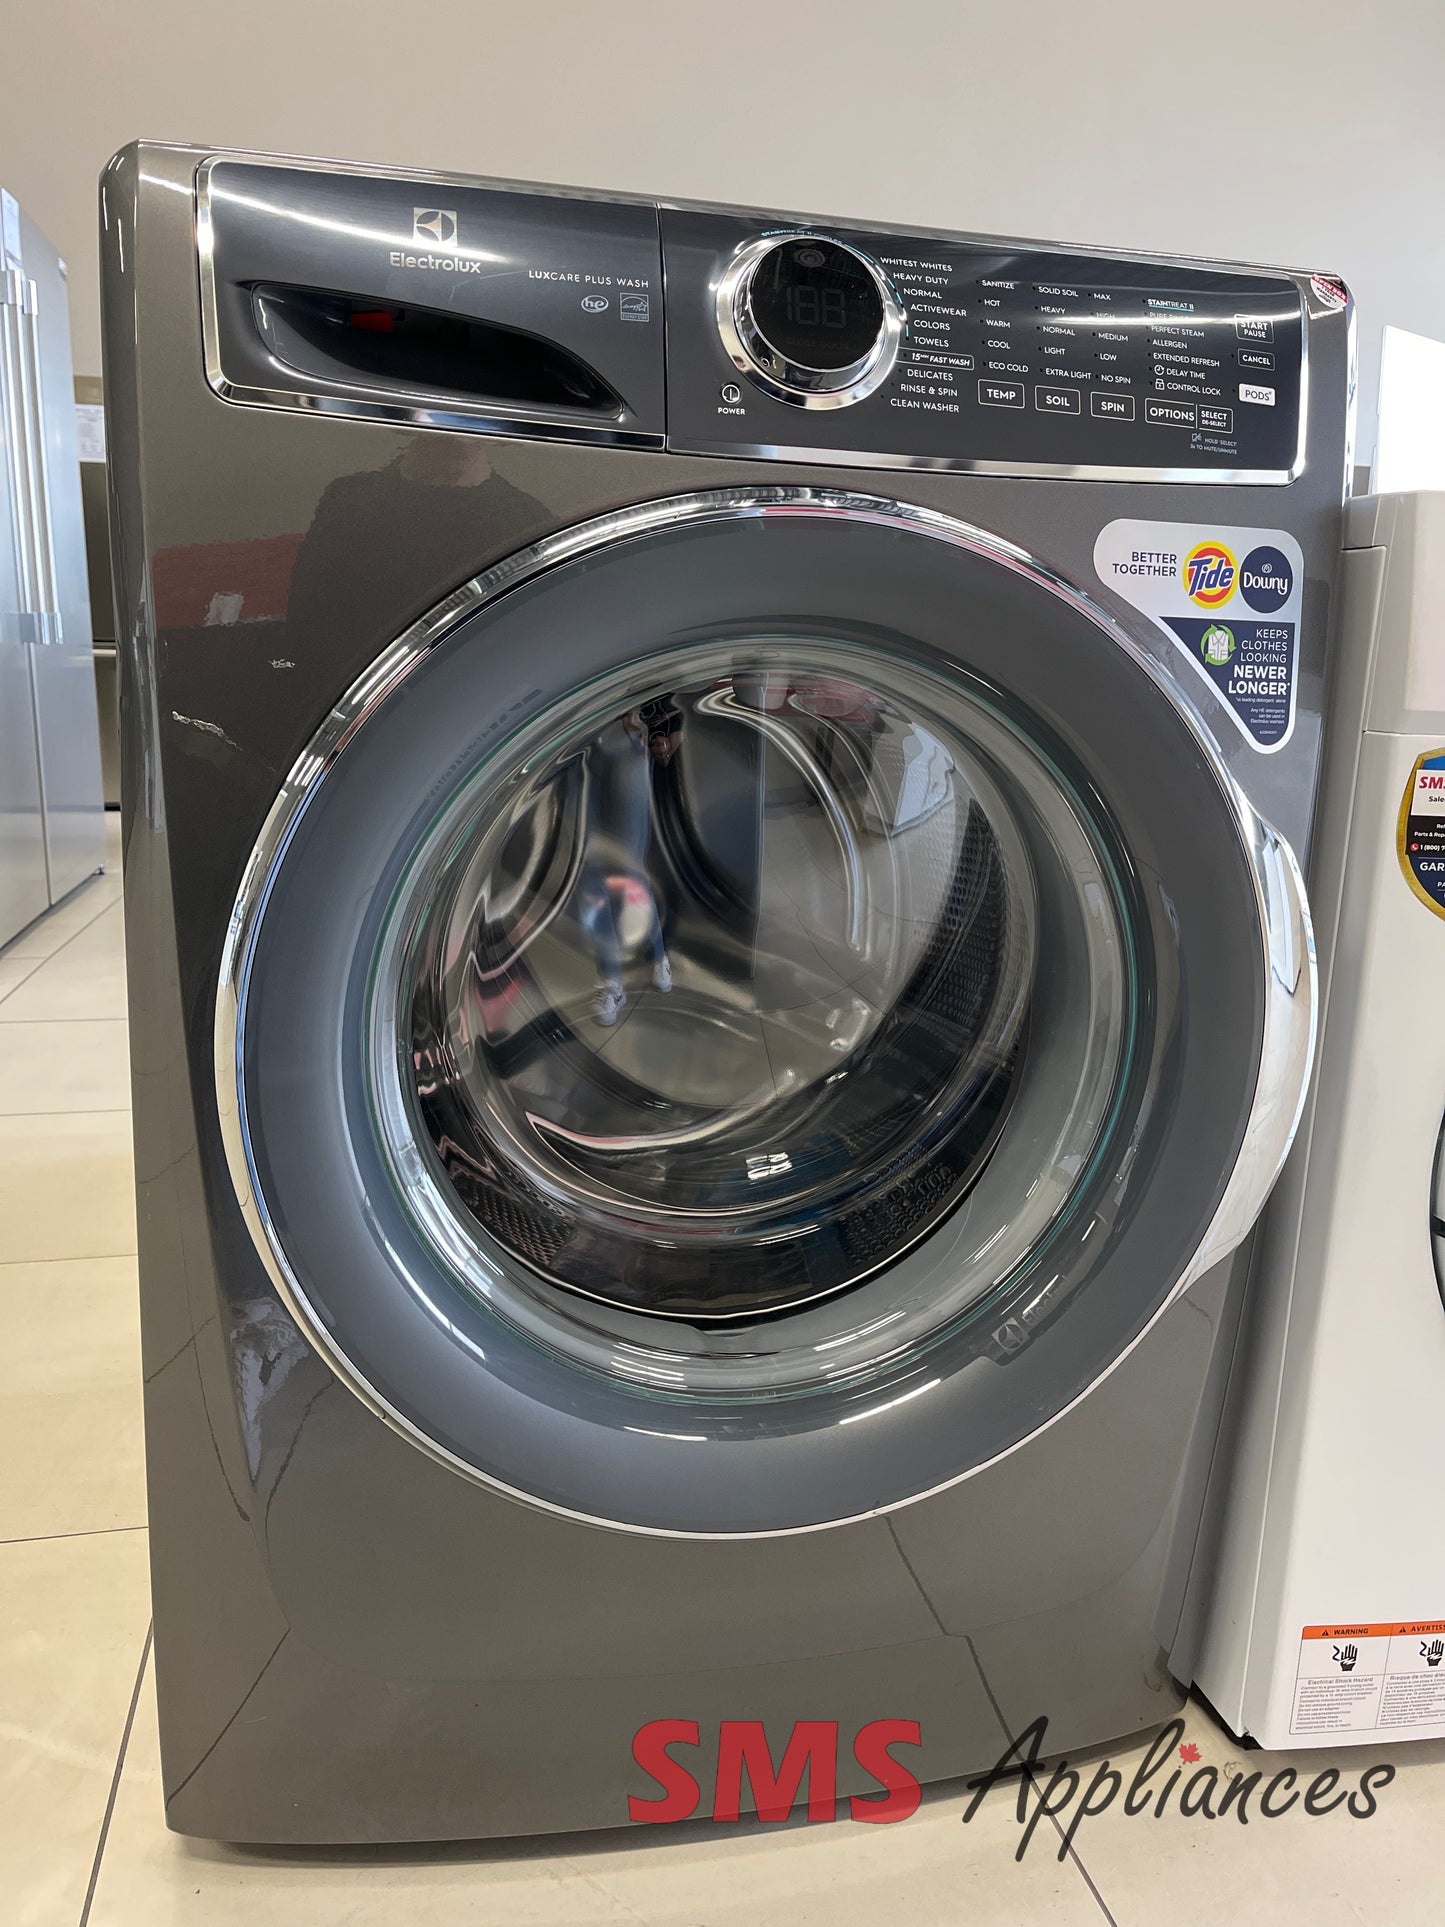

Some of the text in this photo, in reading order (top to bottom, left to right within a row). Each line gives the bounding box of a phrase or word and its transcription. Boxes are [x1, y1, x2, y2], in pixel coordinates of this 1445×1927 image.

[389, 252, 481, 274] Electrolux
[880, 256, 953, 272] WHITEST WHITES
[529, 270, 649, 289] LUXCARE PLUS WASH
[893, 272, 949, 286] HEAVY DUTY
[982, 279, 1015, 290] SANITIZE
[903, 288, 942, 300] NORMAL
[1038, 286, 1079, 297] SOLID SOIL
[1094, 293, 1111, 301] MAX
[984, 298, 1000, 308] HOT
[1147, 298, 1187, 308] STAINTREAT
[910, 303, 967, 317] ACTIVEWEAR
[1041, 305, 1065, 315] HEAVY
[914, 319, 950, 332] COLORS
[986, 318, 1010, 328] WARM
[1241, 321, 1268, 331] START
[1043, 325, 1075, 336] NORMAL
[1151, 325, 1204, 338] PERFECT STEAM
[1244, 330, 1266, 339] PAUSE
[914, 336, 949, 348] TOWELS
[1098, 332, 1128, 342] MEDIUM
[987, 339, 1010, 350] COOL
[1152, 339, 1188, 349] ALLERGEN
[1044, 346, 1065, 356] LIGHT
[1100, 353, 1117, 361] LOW
[929, 355, 948, 364] FAST
[948, 358, 970, 367] WASH
[1153, 352, 1220, 367] EXTENDED REFRESH
[1242, 354, 1271, 365] CANCEL
[989, 361, 1028, 373] ECO COLD
[907, 369, 953, 381] DELICATES
[1045, 367, 1091, 380] EXTRA LIGHT
[1101, 374, 1131, 384] NO SPIN
[1166, 368, 1206, 380] DELAY TIME
[900, 383, 958, 397] RINSE & SPIN
[986, 388, 1016, 401] TEMP
[1167, 383, 1221, 396] CONTROL LOCK
[890, 398, 960, 413] CLEAN WASHER
[1046, 394, 1070, 407] SOIL
[1101, 400, 1125, 413] SPIN
[717, 407, 746, 416] POWER
[1149, 406, 1194, 421] OPTIONS
[1201, 410, 1227, 420] SELECT
[1202, 419, 1226, 427] DE-SELECT
[1131, 551, 1177, 564] BETTER
[1112, 563, 1177, 577] TOGETHER
[1188, 557, 1235, 597] Tide
[1243, 571, 1288, 595] Downy
[1256, 629, 1288, 639] KEEPS
[1241, 640, 1288, 652] CLOTHES
[1240, 652, 1287, 663] LOOKING
[1233, 664, 1287, 680] NEWER
[1419, 776, 1445, 789] SM
[1333, 1628, 1369, 1636] WARNING
